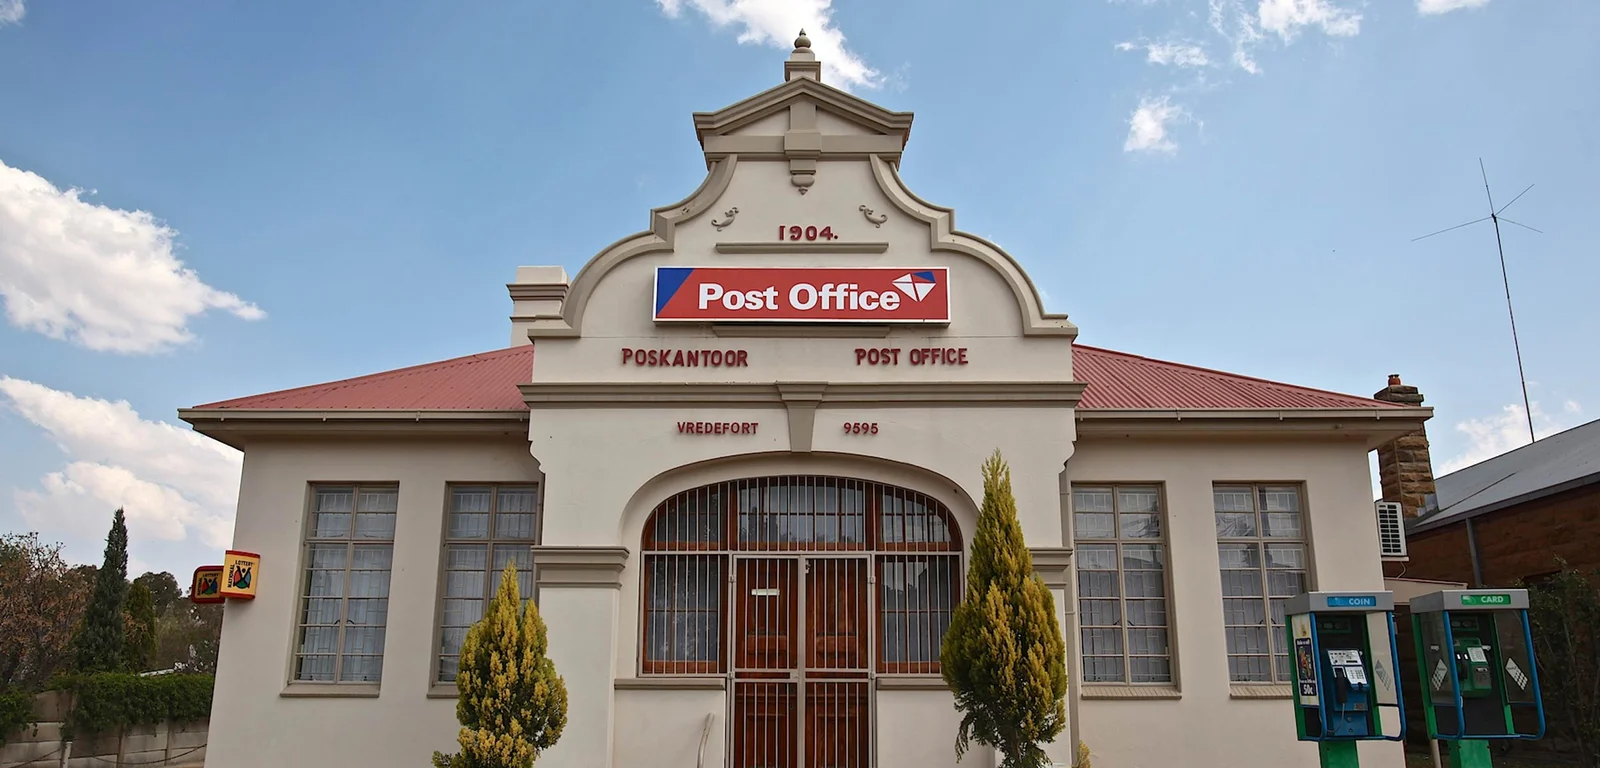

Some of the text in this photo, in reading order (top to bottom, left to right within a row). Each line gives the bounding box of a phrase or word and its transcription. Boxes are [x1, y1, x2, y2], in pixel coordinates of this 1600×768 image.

[698, 283, 900, 311] Post Office
[621, 348, 749, 367] POSKANTOOR
[855, 348, 969, 366] POST OFFICE
[677, 422, 759, 435] VREDEFORT
[843, 422, 879, 435] 9595
[1348, 598, 1371, 606] COIN
[1480, 595, 1504, 604] CARD
